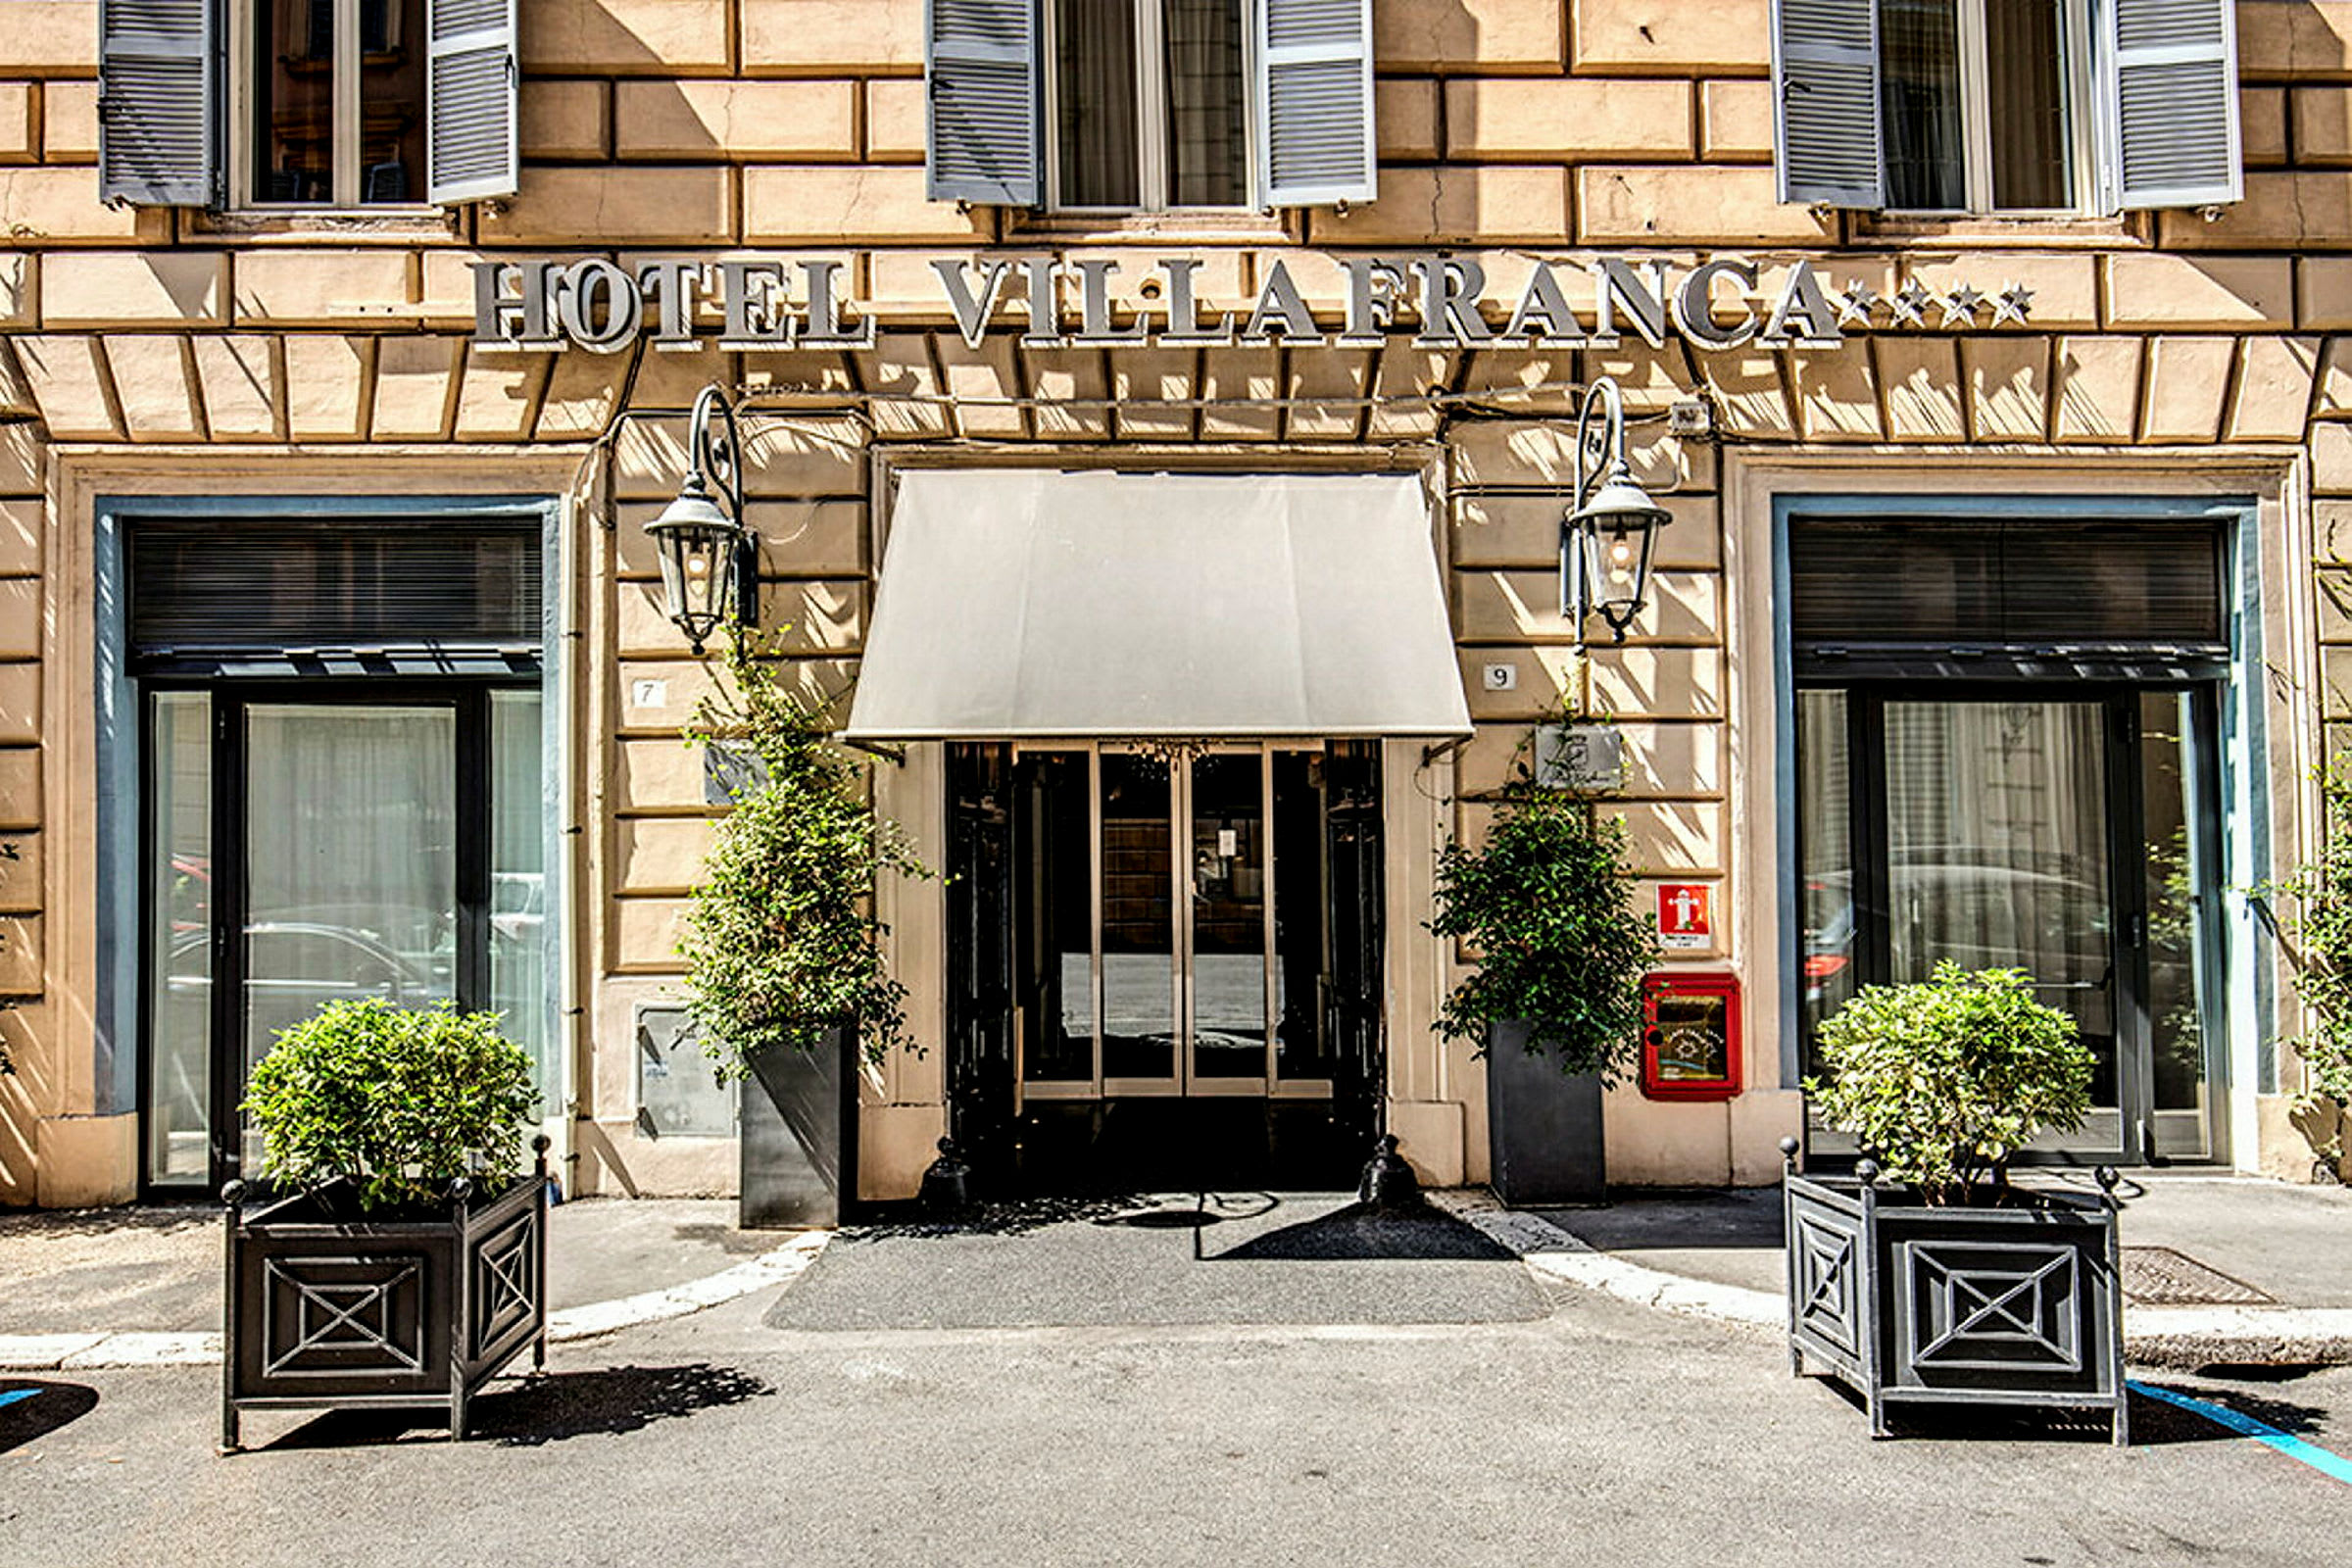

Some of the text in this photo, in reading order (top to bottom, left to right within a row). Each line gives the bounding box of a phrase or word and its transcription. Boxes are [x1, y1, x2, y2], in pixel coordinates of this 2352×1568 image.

[468, 257, 1844, 354] HOTEL VILLAFRANCA
[1494, 667, 1508, 686] 9
[643, 684, 655, 703] 7
